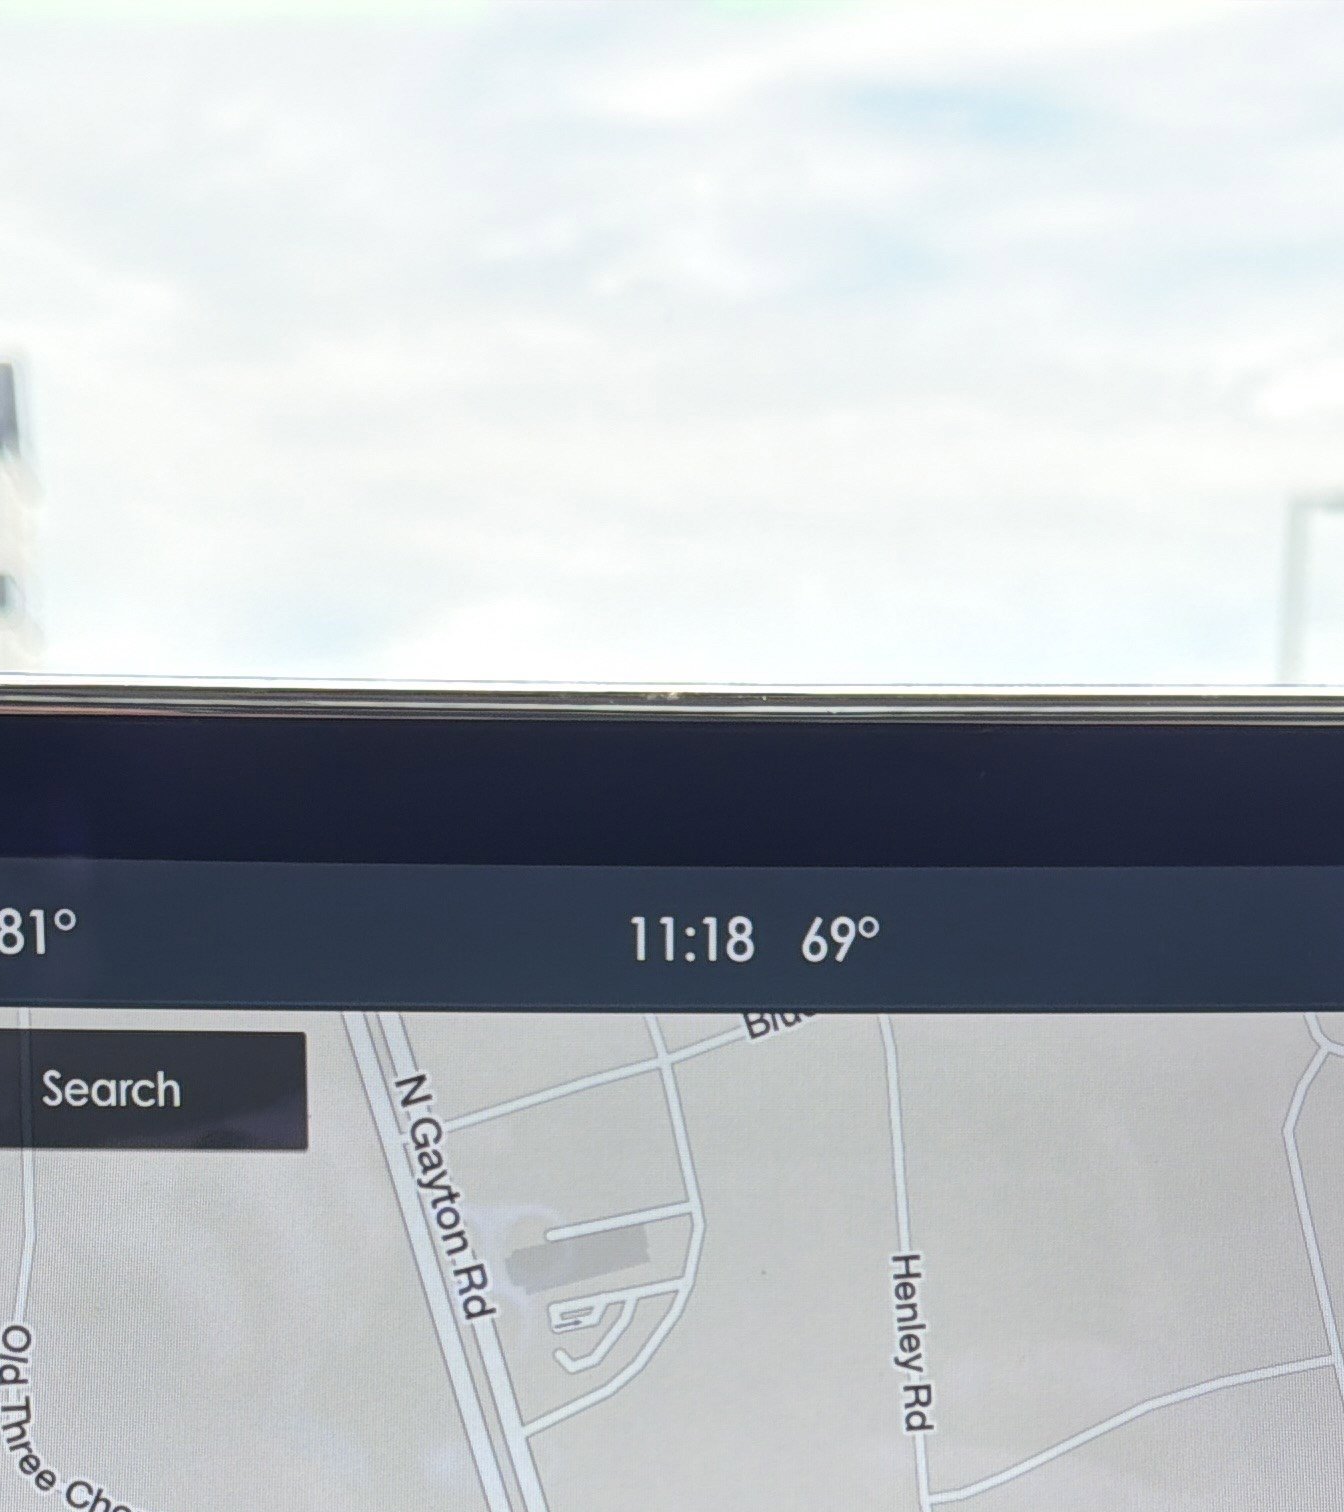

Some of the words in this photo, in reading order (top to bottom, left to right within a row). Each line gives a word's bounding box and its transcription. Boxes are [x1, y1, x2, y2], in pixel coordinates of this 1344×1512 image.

[631, 916, 754, 962] 11:18
[802, 917, 879, 962] 69°
[43, 1070, 180, 1107] Search
[394, 1073, 433, 1108] N
[410, 1117, 469, 1257] Gayton
[453, 1263, 497, 1321] Rd
[891, 1254, 927, 1373] Henley
[903, 1384, 935, 1432] Rd
[0, 1395, 57, 1491] Three
